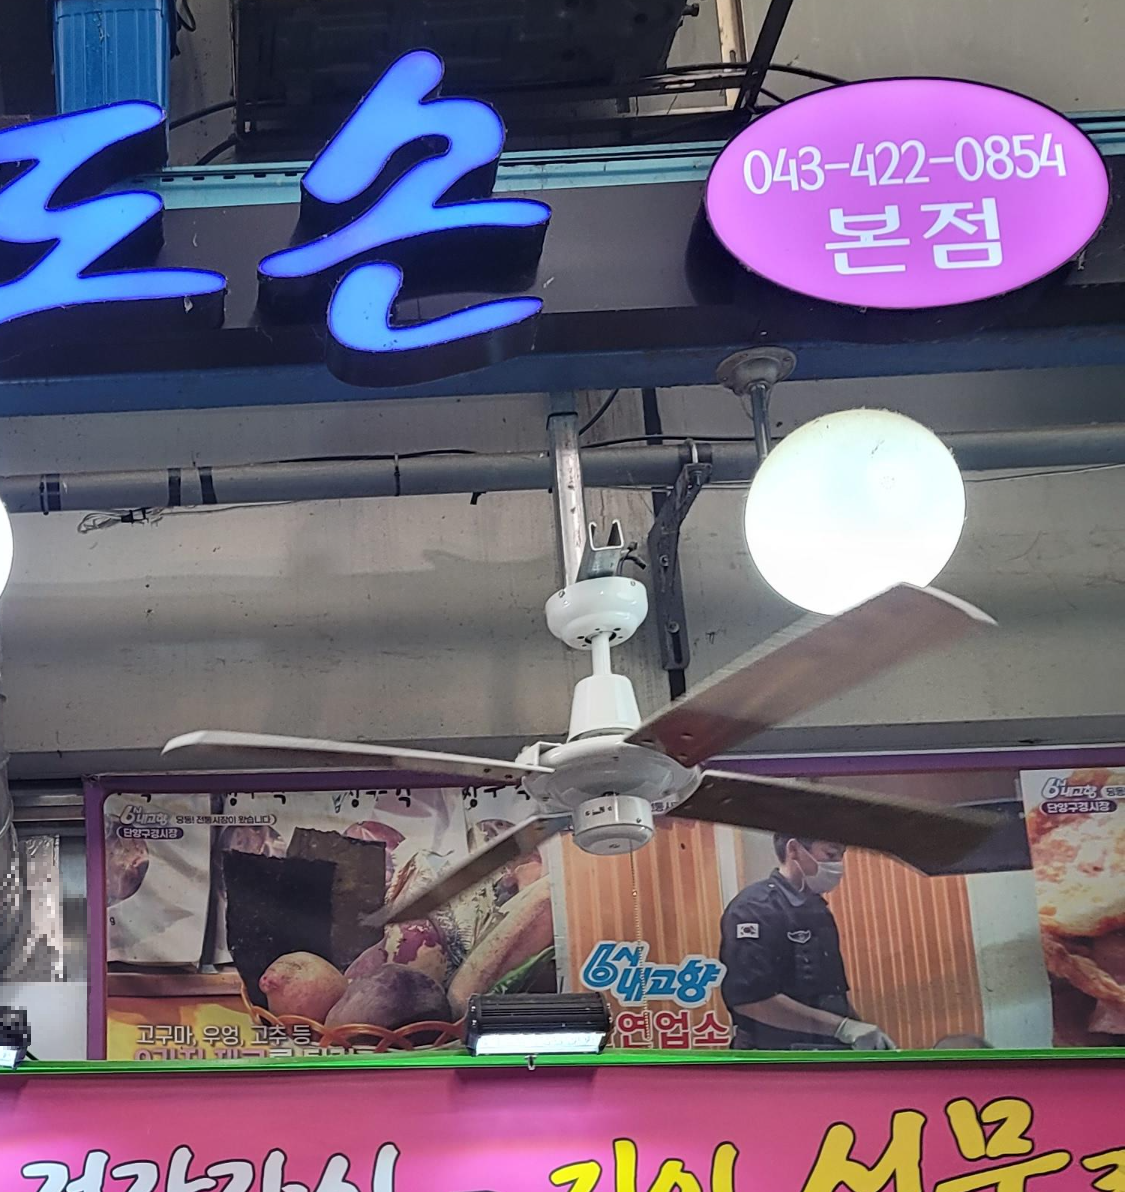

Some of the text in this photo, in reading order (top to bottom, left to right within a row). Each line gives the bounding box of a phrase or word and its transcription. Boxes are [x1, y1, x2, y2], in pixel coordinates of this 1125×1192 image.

[742, 133, 1067, 196] 043-422-0854
[824, 197, 1005, 277] 본점
[123, 827, 179, 839] 단양구경시장
[136, 1025, 311, 1045] 고구마, 우엉, 고추 등
[617, 1011, 731, 1049] 연업소
